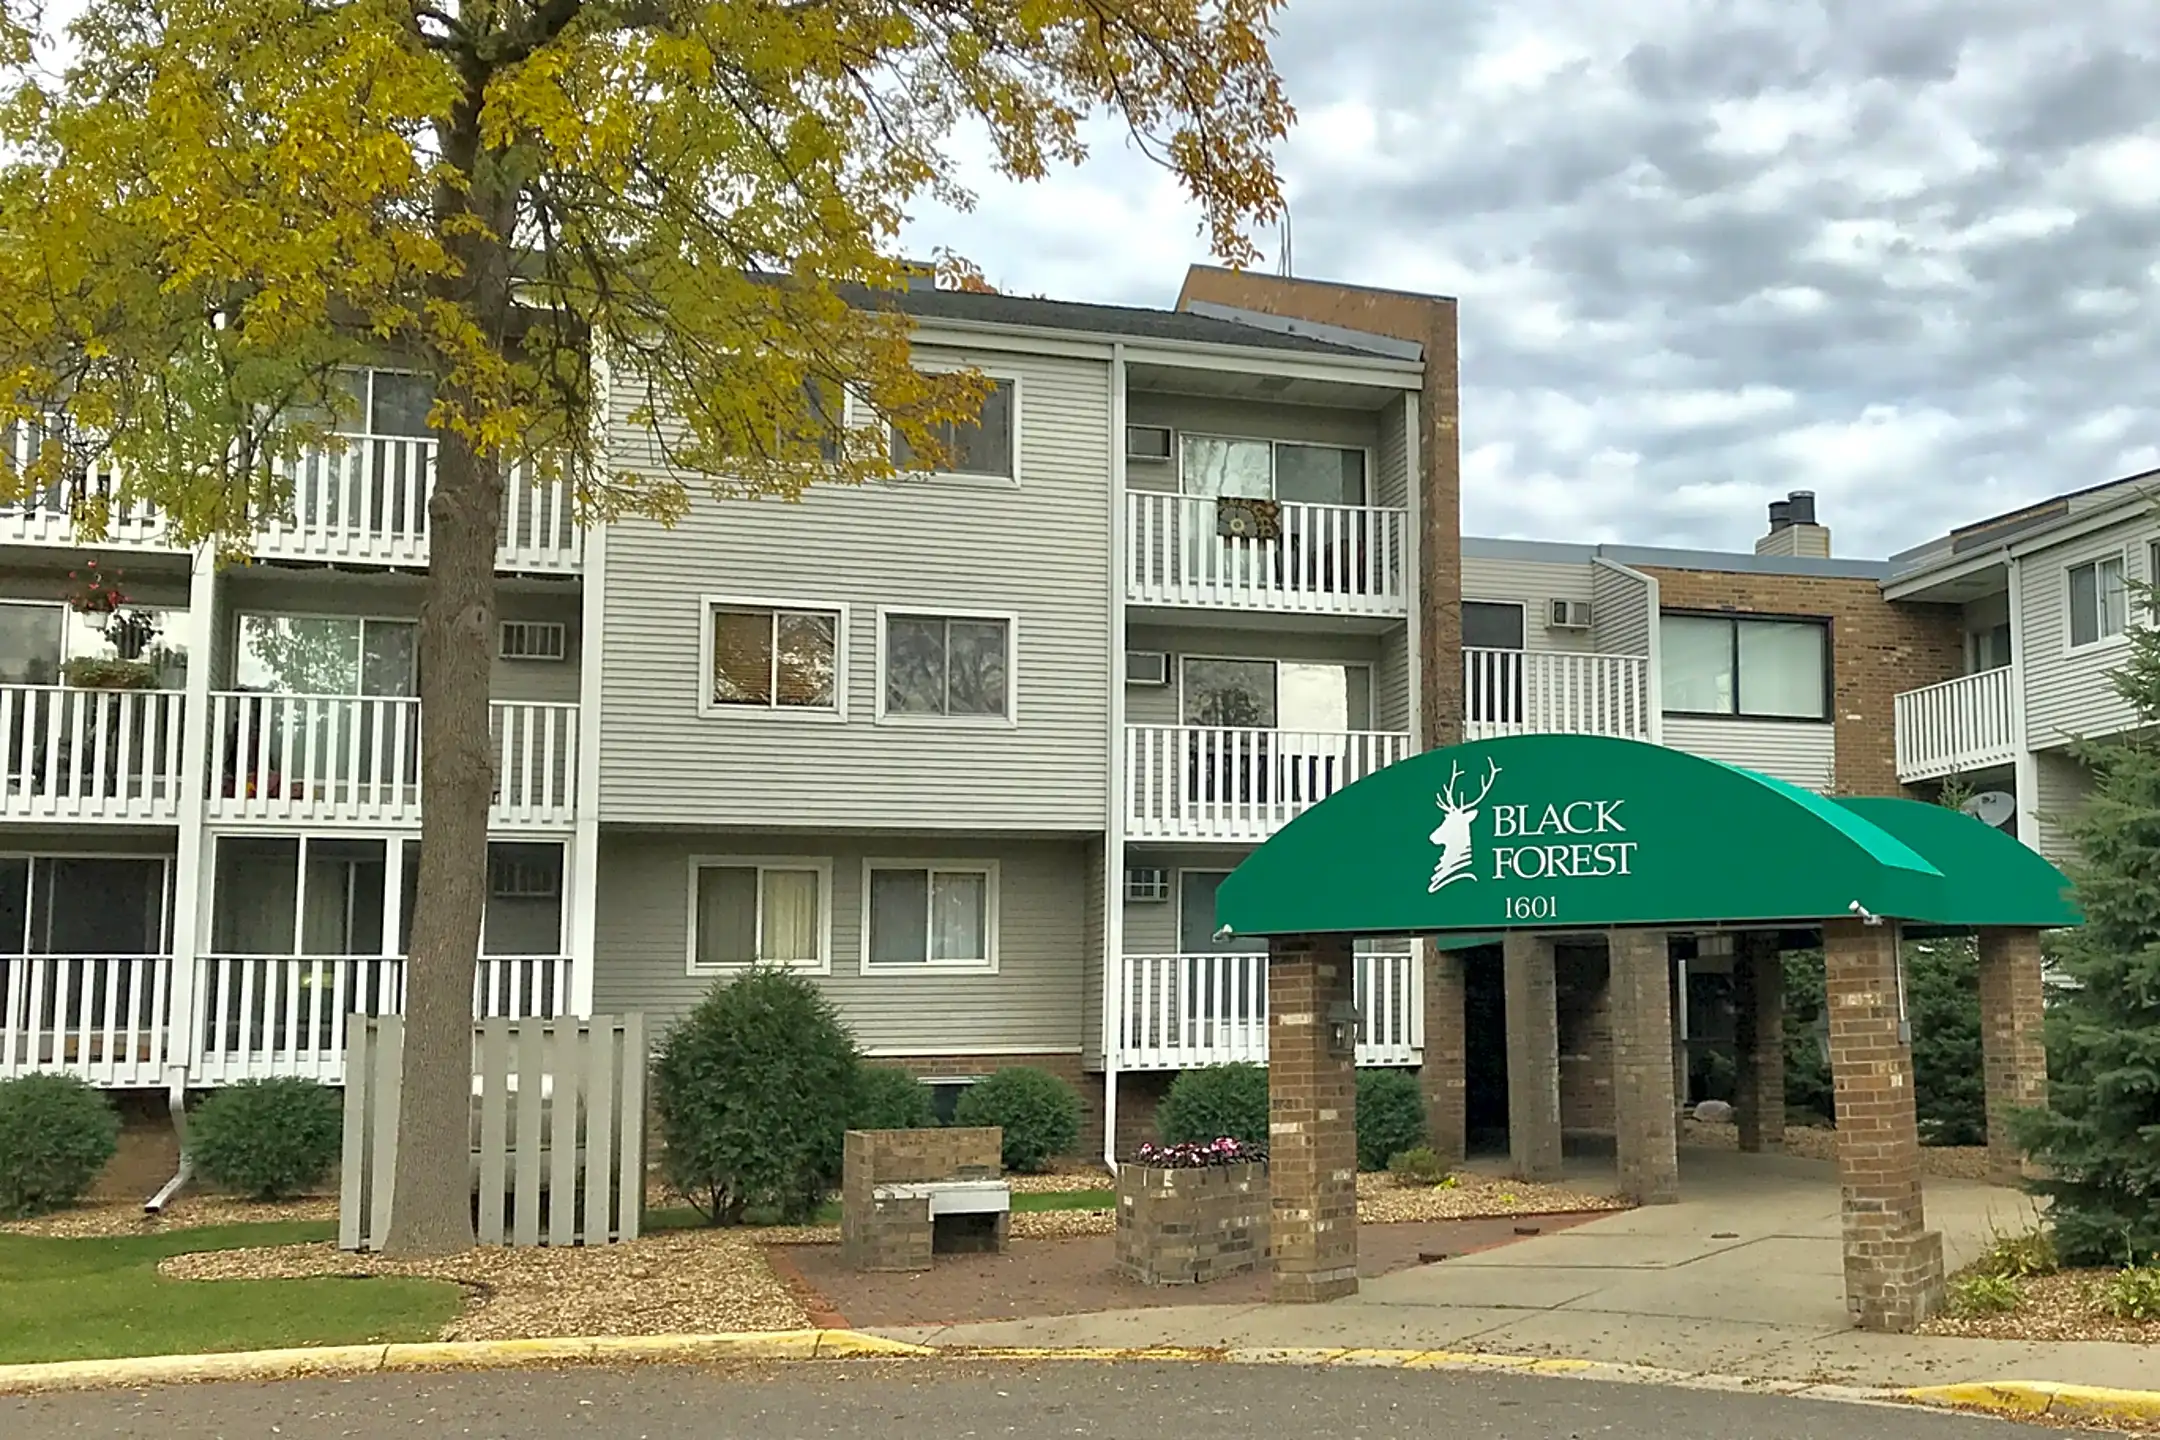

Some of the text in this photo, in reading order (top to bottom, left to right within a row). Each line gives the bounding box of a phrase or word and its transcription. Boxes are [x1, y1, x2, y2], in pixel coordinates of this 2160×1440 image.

[1493, 800, 1626, 837] BLACK
[1493, 843, 1637, 879] FOREST
[1505, 896, 1558, 919] 1601
